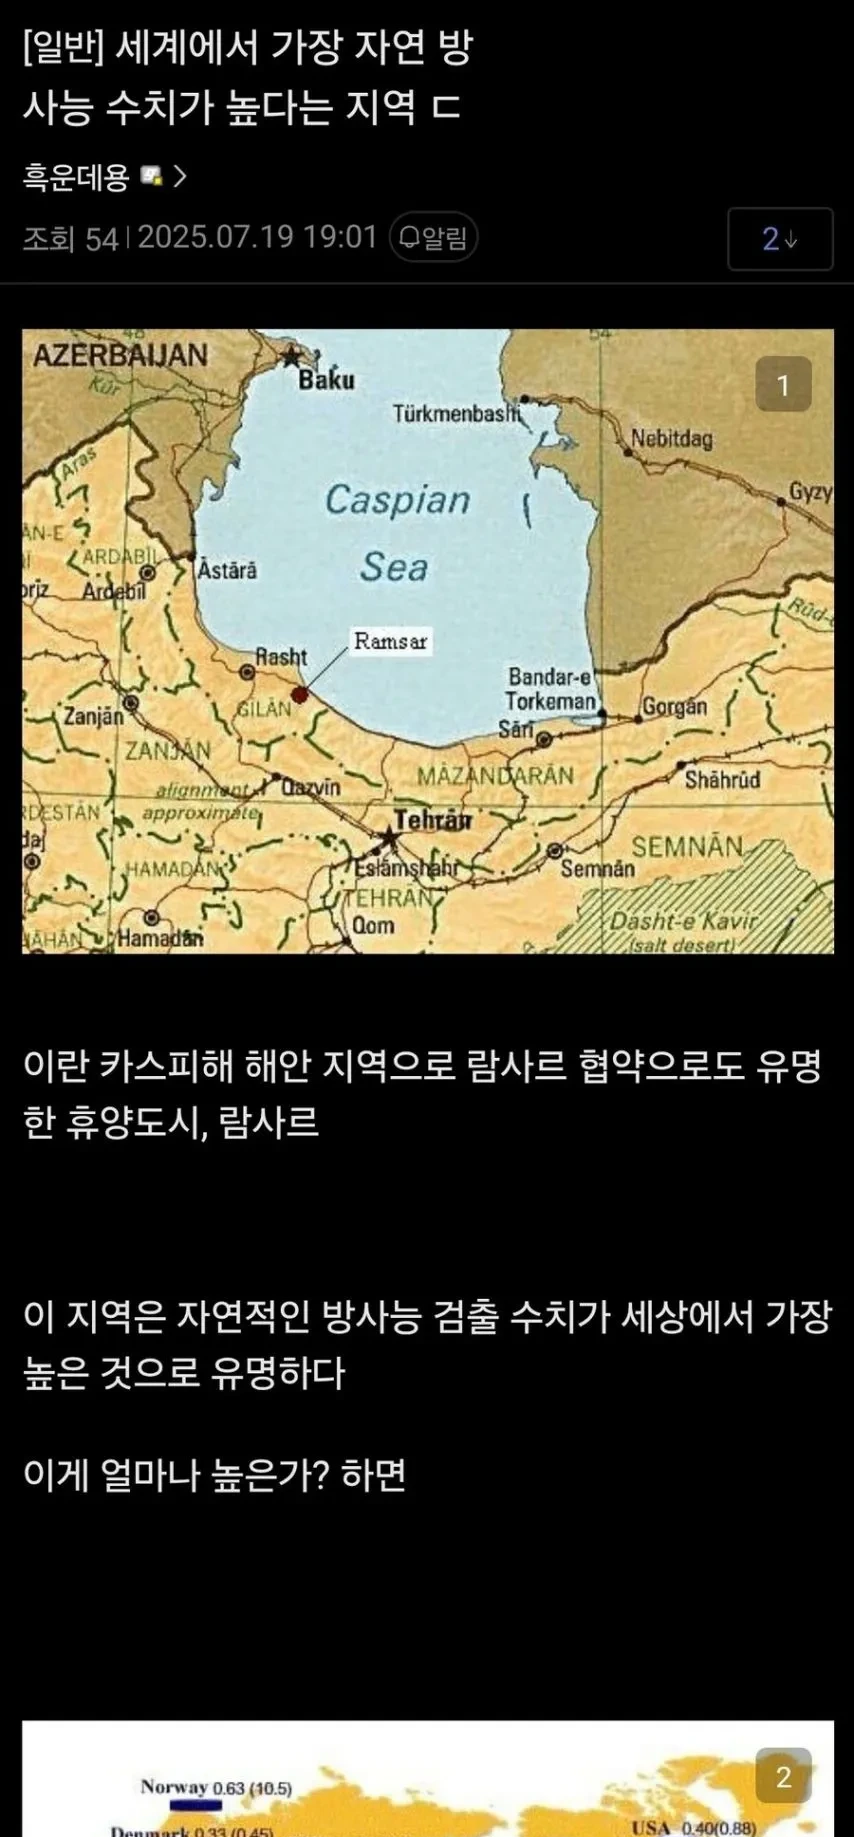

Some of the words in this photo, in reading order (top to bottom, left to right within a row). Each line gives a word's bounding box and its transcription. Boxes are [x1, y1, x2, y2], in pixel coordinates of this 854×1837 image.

[25, 29, 103, 66] [일반]
[116, 29, 256, 65] 세계에서
[273, 29, 344, 66] 가장
[355, 29, 424, 65] 자연
[440, 29, 473, 66] 방
[23, 89, 94, 126] 사능
[107, 89, 214, 125] 수치가
[227, 89, 333, 126] 높다는
[347, 89, 413, 125] 지역
[433, 97, 460, 117] ㄷ
[23, 163, 130, 192] 흑운데용
[23, 226, 74, 253] 조회
[86, 228, 119, 251] 54
[138, 225, 294, 249] 2025.07.19
[304, 225, 376, 249] 19:01
[422, 226, 467, 251] 알림
[763, 227, 780, 251] 2
[33, 343, 208, 367] AZERBAIJAN
[299, 369, 355, 390] Baku
[632, 428, 713, 451] Nebitdag
[60, 447, 97, 482] Aras
[326, 483, 470, 521] Caspian
[360, 551, 428, 581] Sea
[354, 631, 428, 651] Ramsar
[256, 648, 307, 667] Rasht
[509, 667, 591, 686] Bandar-e
[505, 691, 596, 711] Torkeman
[156, 782, 248, 800] alignment
[352, 915, 395, 937] Qom
[610, 911, 694, 930] Dasht-e
[25, 1049, 90, 1083] 이란
[101, 1049, 232, 1083] 카스피해
[246, 1049, 312, 1083] 해안
[323, 1050, 456, 1083] 지역으로
[469, 1049, 567, 1083] 람사르
[580, 1049, 745, 1083] 협약으로도
[757, 1050, 820, 1083] 유명
[25, 1459, 87, 1492] 이게
[102, 1458, 201, 1492] 얼마나
[212, 1458, 329, 1493] 높은가?
[342, 1458, 404, 1492] 하면
[140, 1779, 208, 1797] Norway
[213, 1782, 245, 1796] 0.63
[250, 1781, 292, 1798] (10.5)
[632, 1820, 671, 1836] USA
[682, 1821, 757, 1837] 0.40(0.88)
